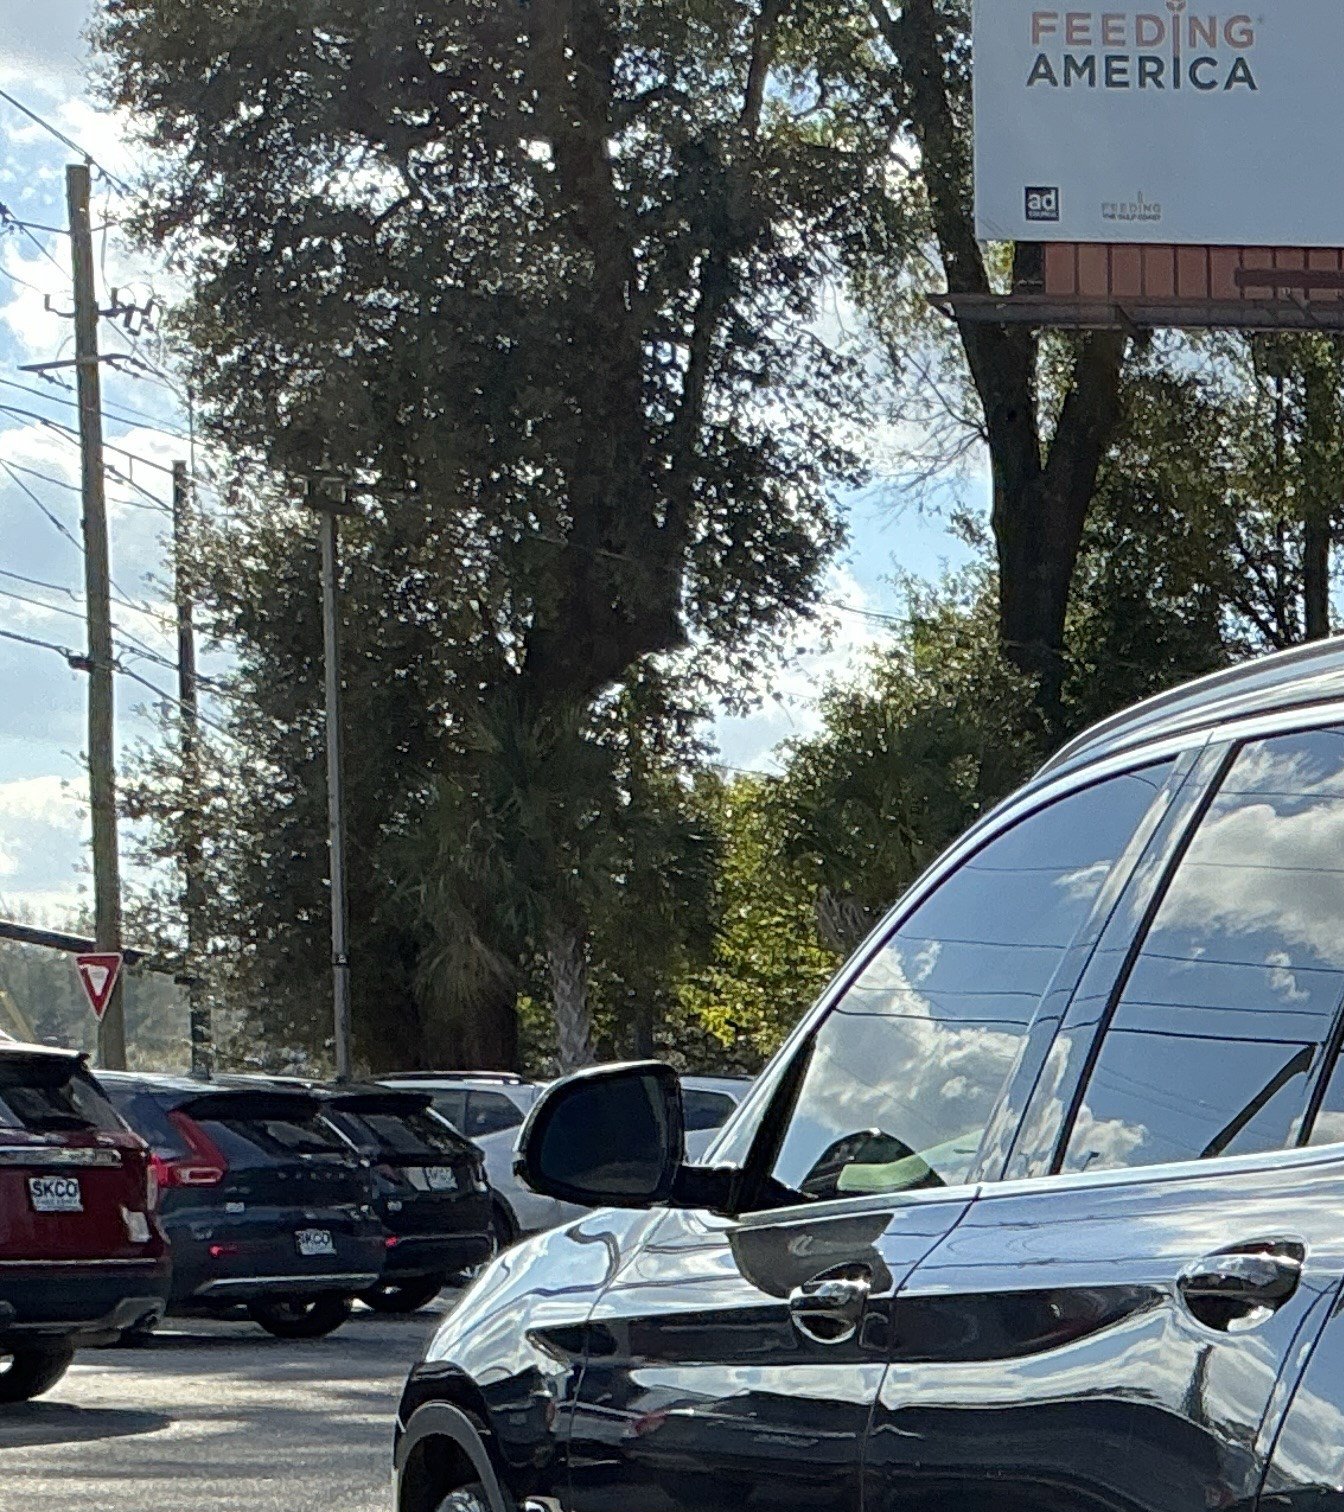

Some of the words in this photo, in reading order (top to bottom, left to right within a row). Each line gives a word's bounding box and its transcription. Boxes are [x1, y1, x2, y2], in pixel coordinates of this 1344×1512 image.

[1031, 11, 1255, 50] FEEDING
[1026, 53, 1258, 90] AMERICA
[1028, 190, 1056, 210] ad
[32, 1180, 78, 1197] SKCO
